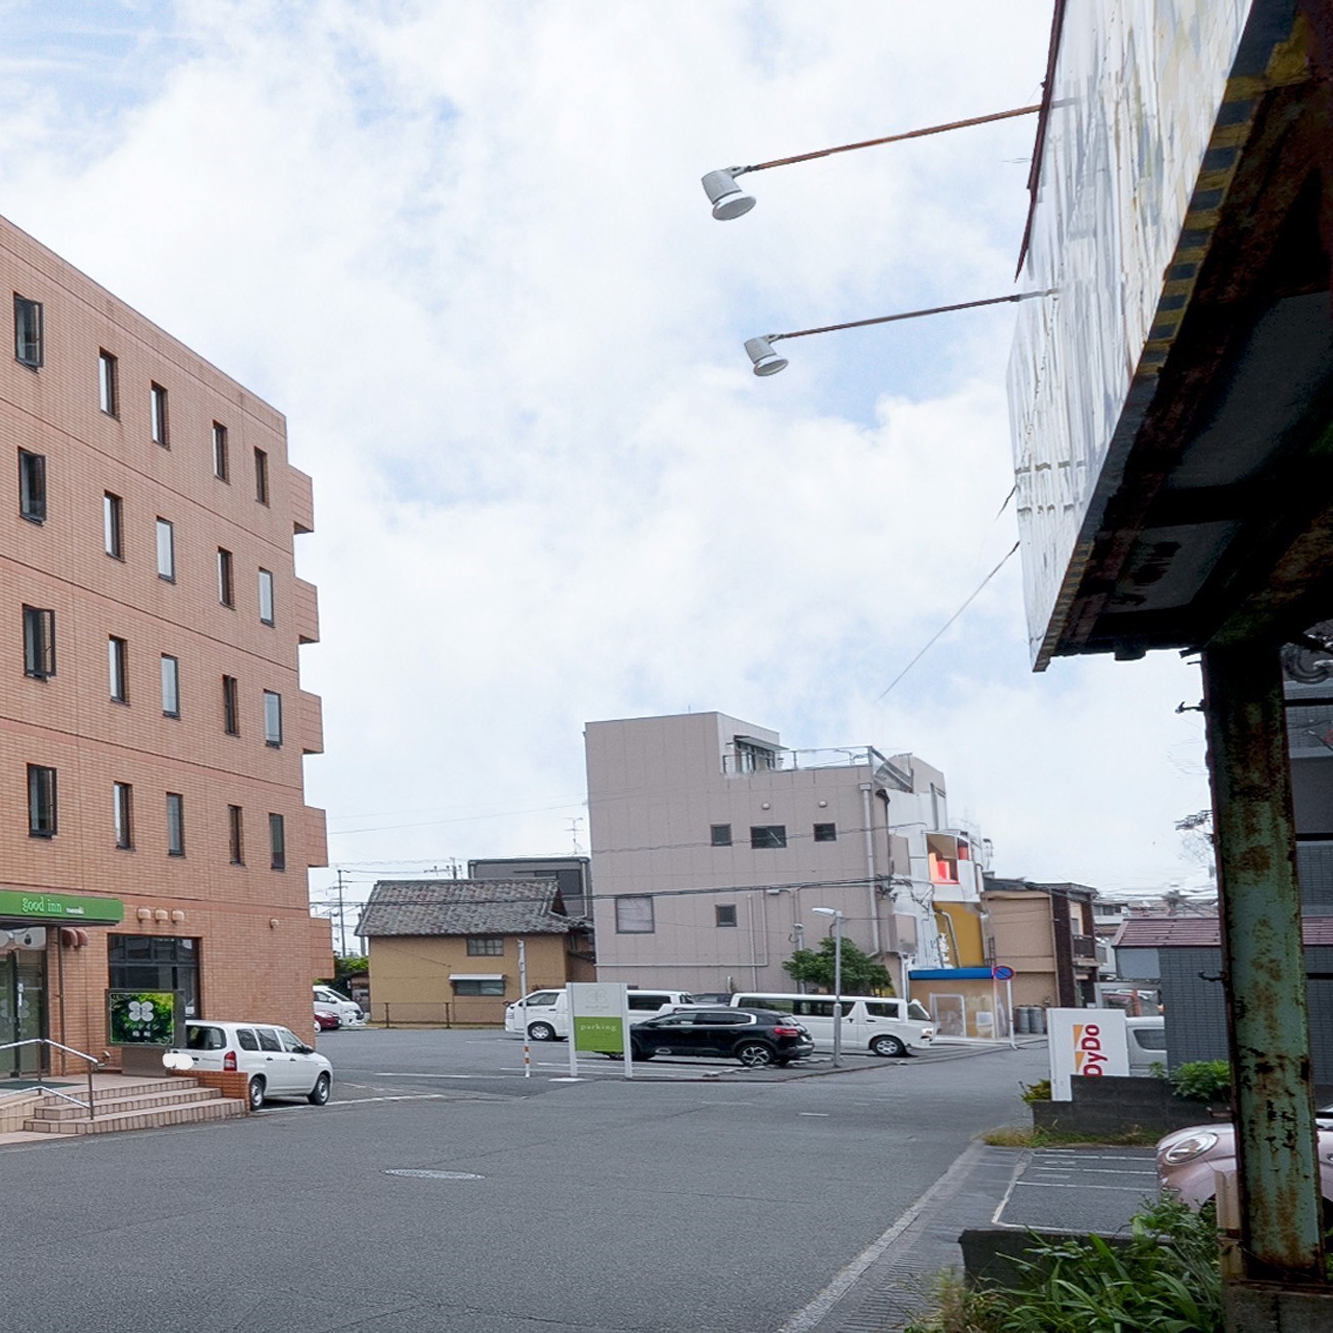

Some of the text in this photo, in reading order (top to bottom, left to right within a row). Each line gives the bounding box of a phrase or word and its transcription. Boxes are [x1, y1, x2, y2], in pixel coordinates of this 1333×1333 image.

[22, 896, 44, 913] good
[47, 899, 62, 914] inn
[1081, 1024, 1108, 1078] DyDo
